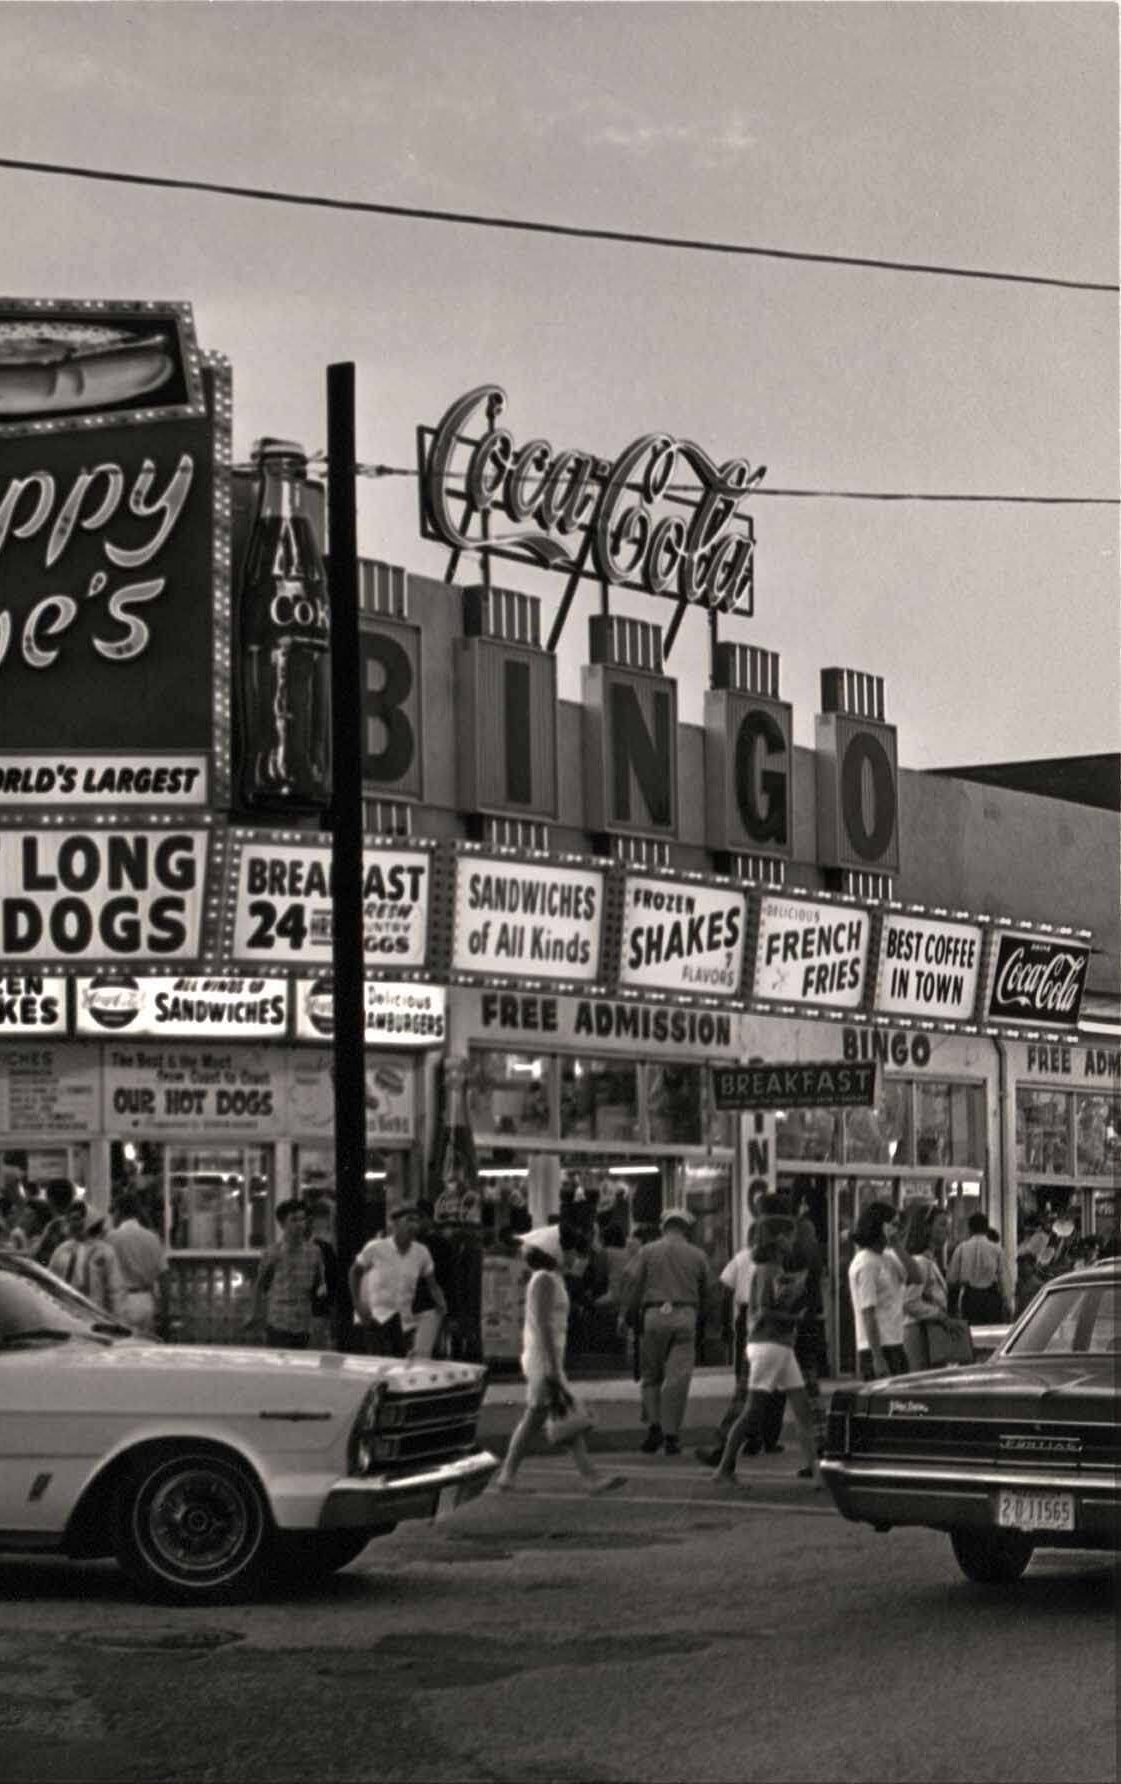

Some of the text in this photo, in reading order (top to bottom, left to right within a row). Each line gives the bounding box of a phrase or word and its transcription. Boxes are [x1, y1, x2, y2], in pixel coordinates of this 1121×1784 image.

[427, 384, 767, 613] Coca-Cola
[270, 595, 331, 628] Cok
[361, 630, 898, 860] BINGO
[83, 766, 200, 795] LARGEST
[21, 834, 197, 894] LONG
[247, 857, 426, 903] BREAAST
[364, 902, 414, 920] RESH
[468, 873, 597, 922] SANDWICHES
[632, 887, 696, 915] FROZEN
[763, 903, 822, 924] DELICIOUS
[1, 896, 188, 955] DOGS
[245, 900, 332, 951] 24 HR
[364, 921, 411, 933] UNTRY
[364, 934, 411, 953] GGS
[468, 919, 592, 965] of All Kinds
[627, 905, 742, 971] SHAKES
[765, 919, 864, 968] FRENCH
[886, 927, 977, 970] BEST COFFEE
[680, 964, 736, 989] FLAVORS
[801, 956, 863, 999] FRIES
[890, 966, 965, 1006] IN TOWN
[996, 945, 1087, 1014] Coca-Cola
[155, 991, 285, 1027] SANDWICHES
[366, 1010, 445, 1038] AMBURGERS
[480, 993, 733, 1048] FREE ADMISSION
[842, 1027, 932, 1069] BINGO
[1026, 1043, 1073, 1075] FREE
[112, 1086, 156, 1116] OUR
[164, 1088, 208, 1116] HOT
[216, 1088, 274, 1117] DOGS
[720, 1068, 871, 1097] BREAKFAST
